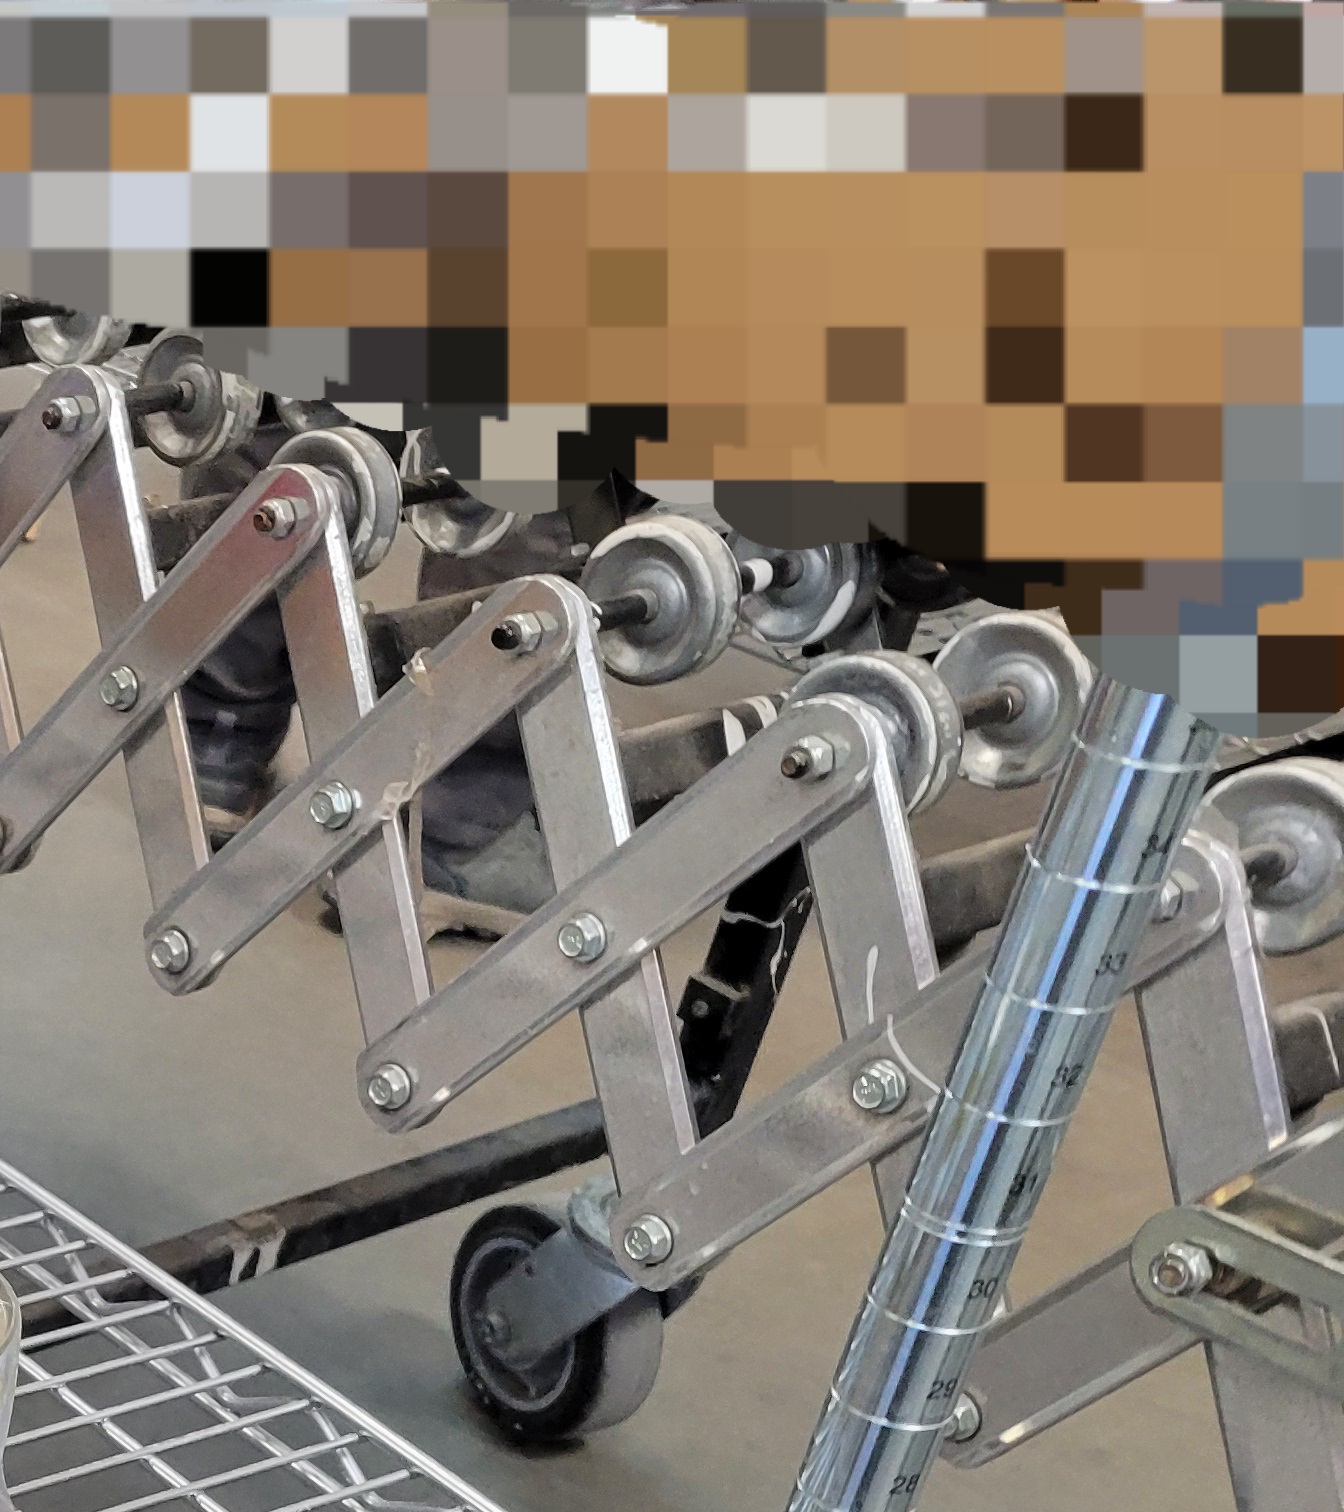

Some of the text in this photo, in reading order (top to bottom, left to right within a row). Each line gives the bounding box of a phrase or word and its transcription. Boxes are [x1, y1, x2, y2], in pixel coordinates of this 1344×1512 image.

[967, 1278, 1000, 1301] 30
[925, 1377, 960, 1400] 29
[888, 1472, 921, 1496] 28
